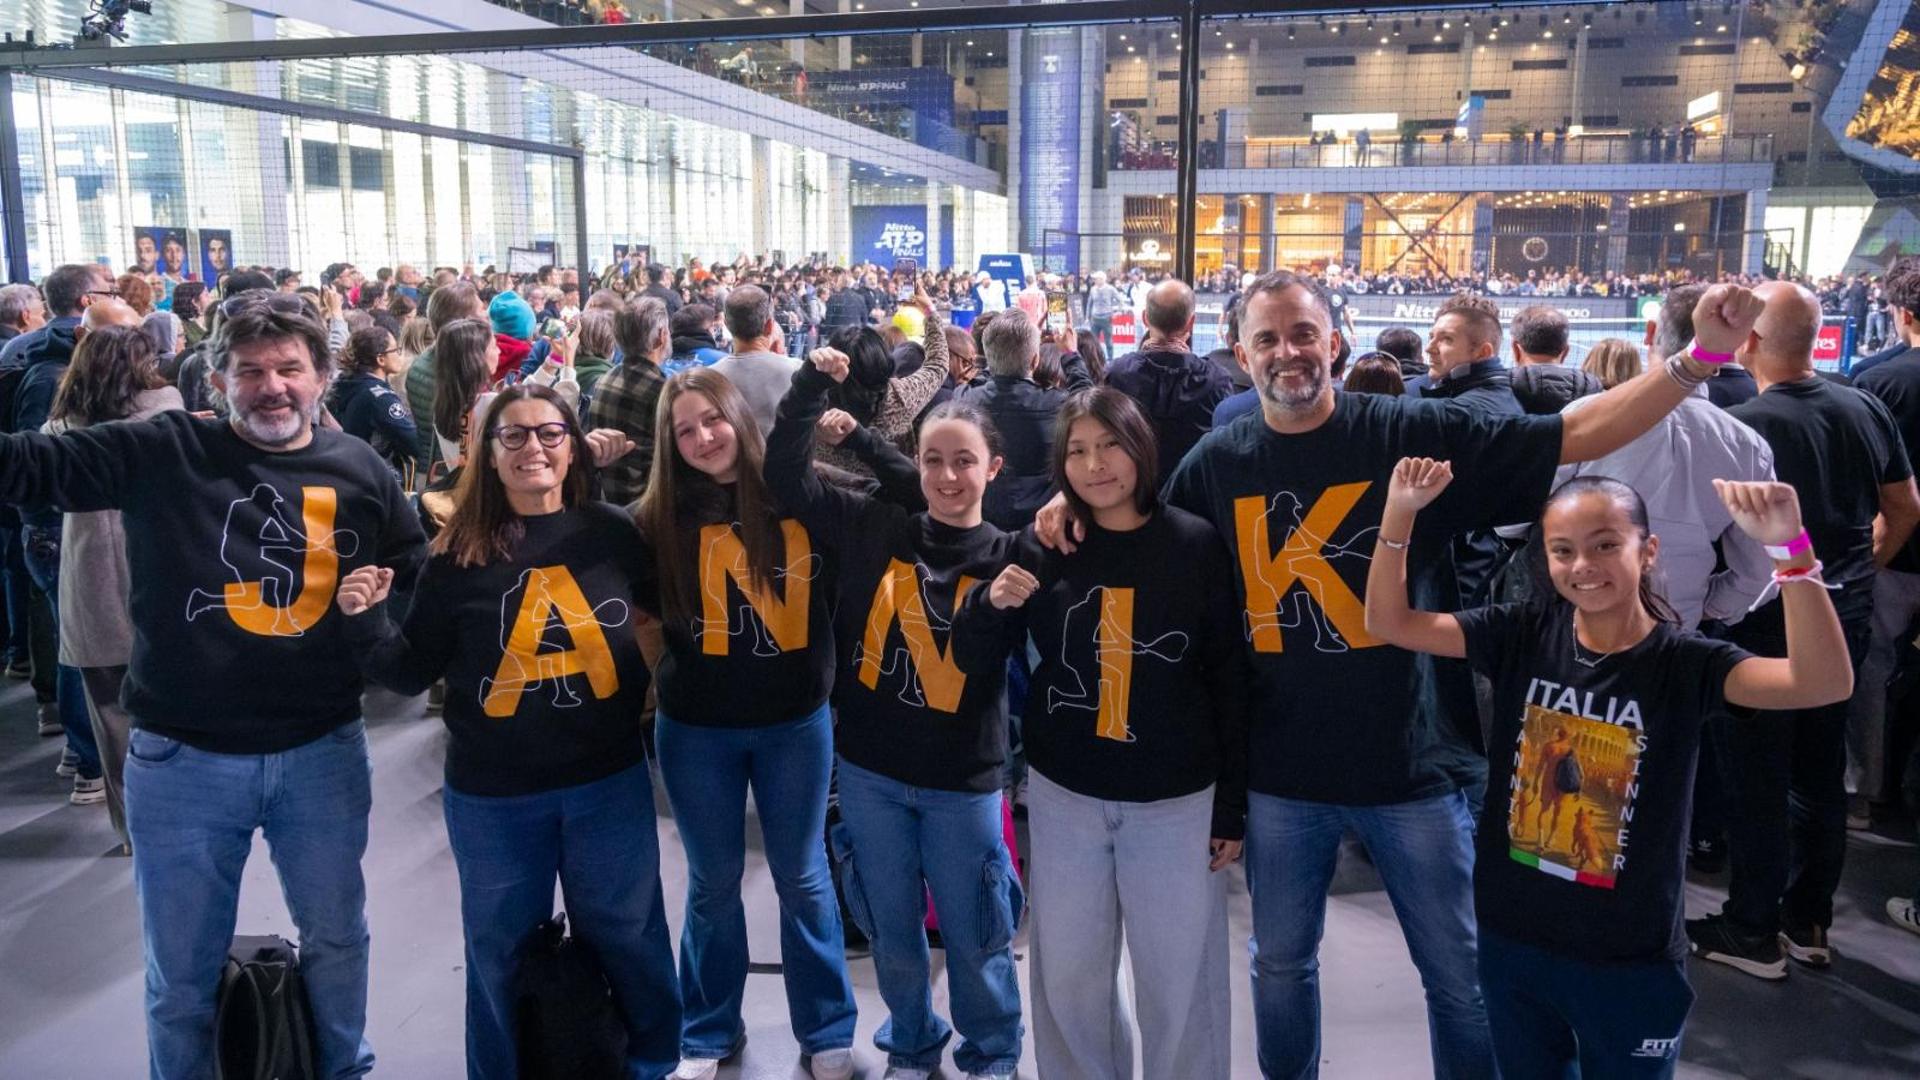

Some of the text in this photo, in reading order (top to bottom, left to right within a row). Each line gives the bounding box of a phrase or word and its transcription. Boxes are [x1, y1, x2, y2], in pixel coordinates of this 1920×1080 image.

[874, 230, 925, 249] ATP
[885, 223, 916, 231] Nitto
[892, 246, 924, 257] FINALS
[224, 486, 338, 636] J
[700, 518, 812, 656] N
[1234, 481, 1390, 653] K
[483, 565, 620, 718] A
[858, 556, 978, 714] N
[1096, 587, 1135, 740] I
[1524, 677, 1645, 732] ITALIA
[1612, 735, 1648, 871] SINNER
